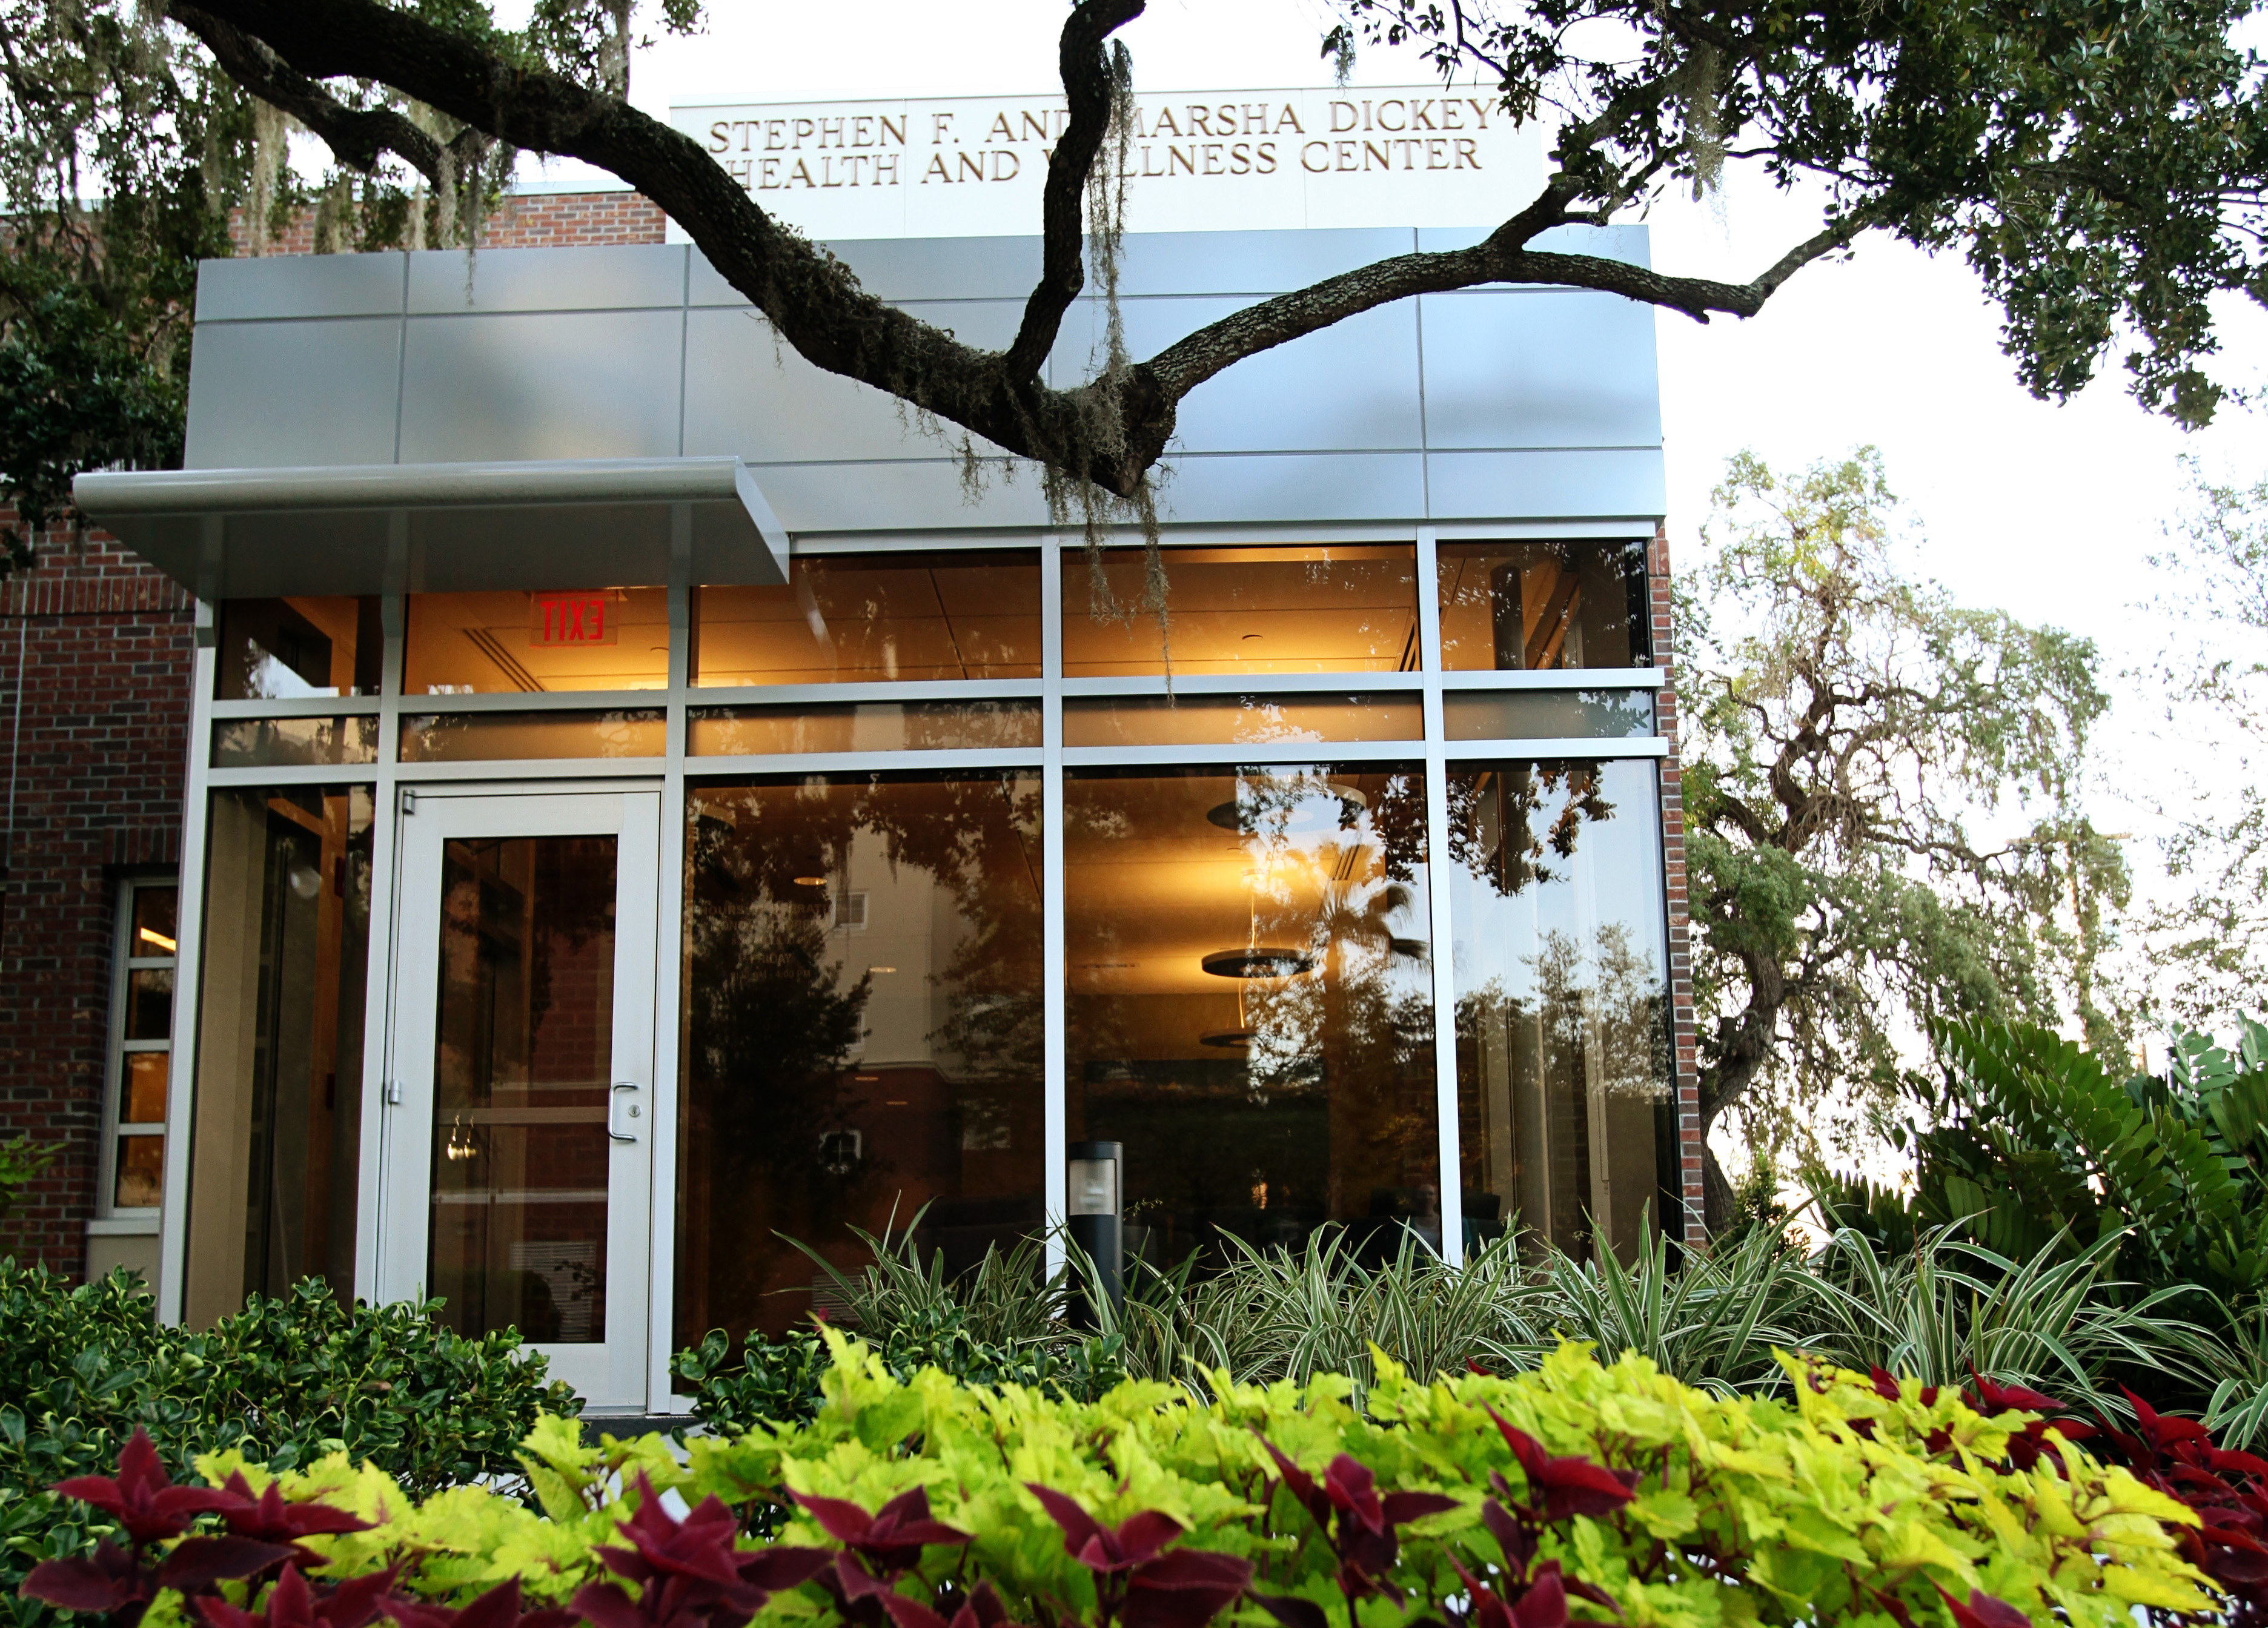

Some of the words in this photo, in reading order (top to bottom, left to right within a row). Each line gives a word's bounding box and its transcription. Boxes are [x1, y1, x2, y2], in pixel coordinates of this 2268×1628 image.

[708, 114, 907, 153] STEPHEN
[932, 113, 960, 144] F.
[1329, 98, 1497, 133] DICKEY
[726, 153, 900, 192] HEALTH
[921, 150, 1021, 184] AND
[1042, 141, 1278, 179] LLNESS
[1300, 137, 1483, 174] CENTER
